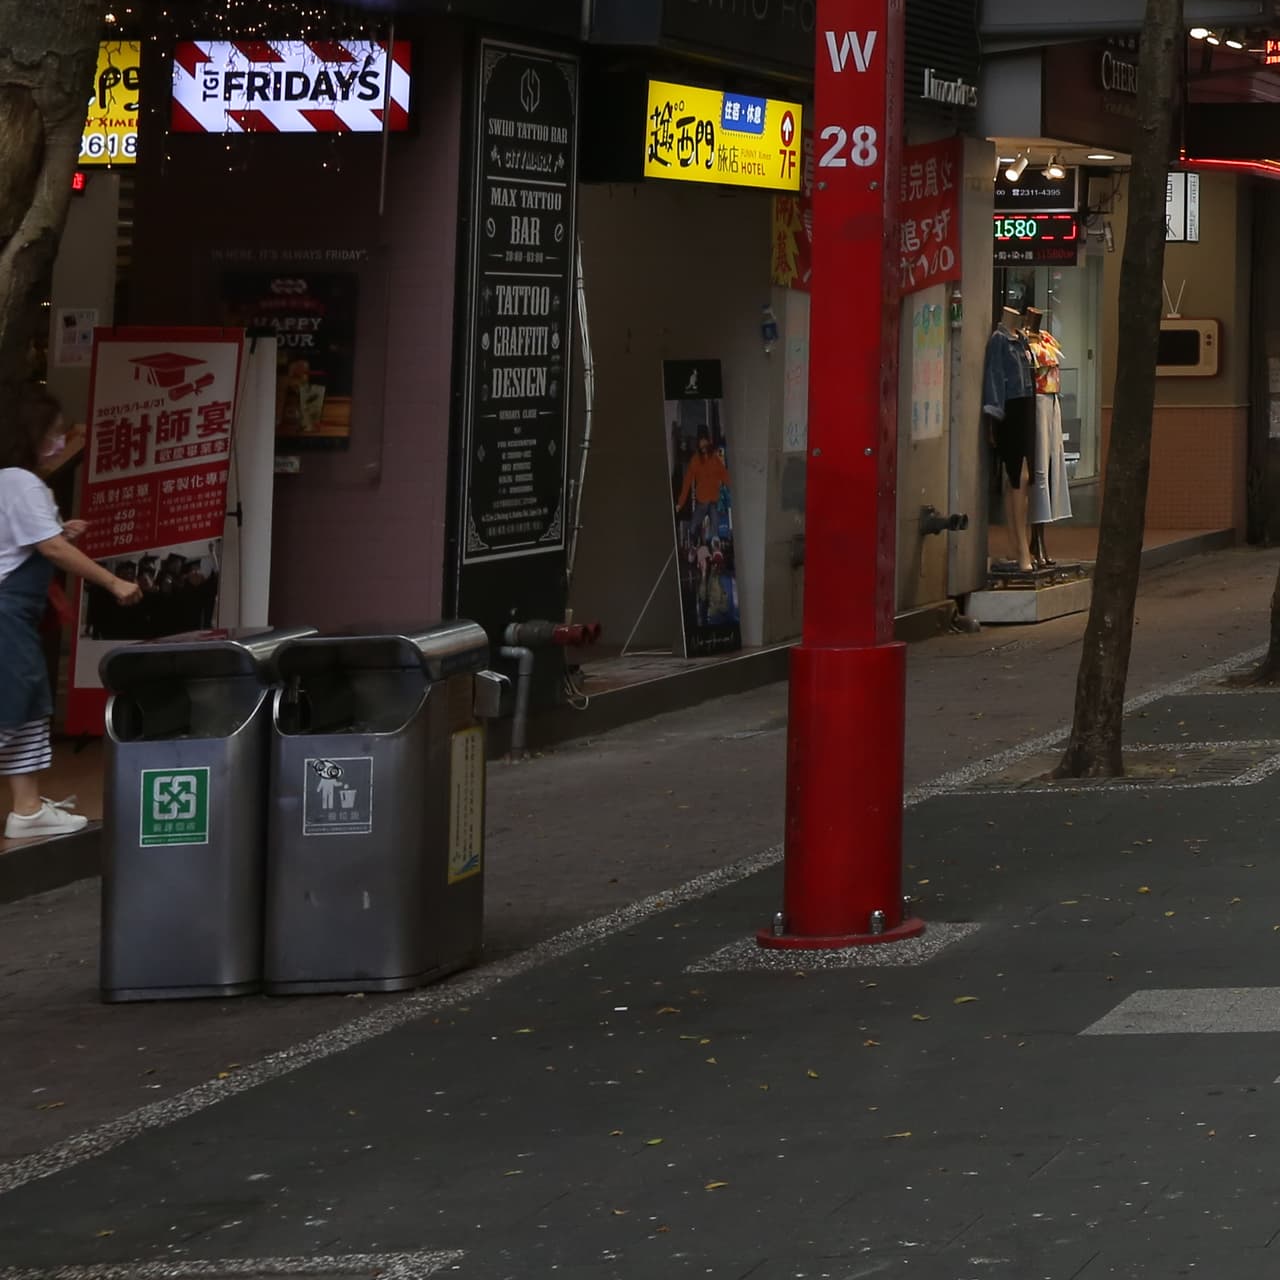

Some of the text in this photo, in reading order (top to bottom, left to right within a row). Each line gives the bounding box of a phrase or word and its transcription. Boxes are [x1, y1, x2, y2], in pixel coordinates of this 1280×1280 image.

[824, 30, 878, 73] W
[202, 70, 380, 102] TGI FRIDAYS
[517, 122, 549, 142] TATTOO
[551, 126, 568, 144] BAR
[818, 125, 879, 168] 28
[717, 144, 739, 173] 旅店
[741, 161, 766, 176] HOTEL
[779, 149, 797, 180] 7F
[491, 187, 562, 210] MAX TATTOO
[510, 215, 541, 245] BAR
[994, 219, 1038, 237] 1580
[495, 285, 550, 315] TATTOO
[254, 317, 322, 332] HAPPY
[276, 334, 315, 348] OUR
[493, 326, 549, 357] GRAFFITI
[491, 367, 547, 398] DESIGN
[95, 400, 232, 475] 謝師宴
[112, 521, 135, 534] 600
[114, 509, 136, 521] 450
[112, 533, 133, 546] 750
